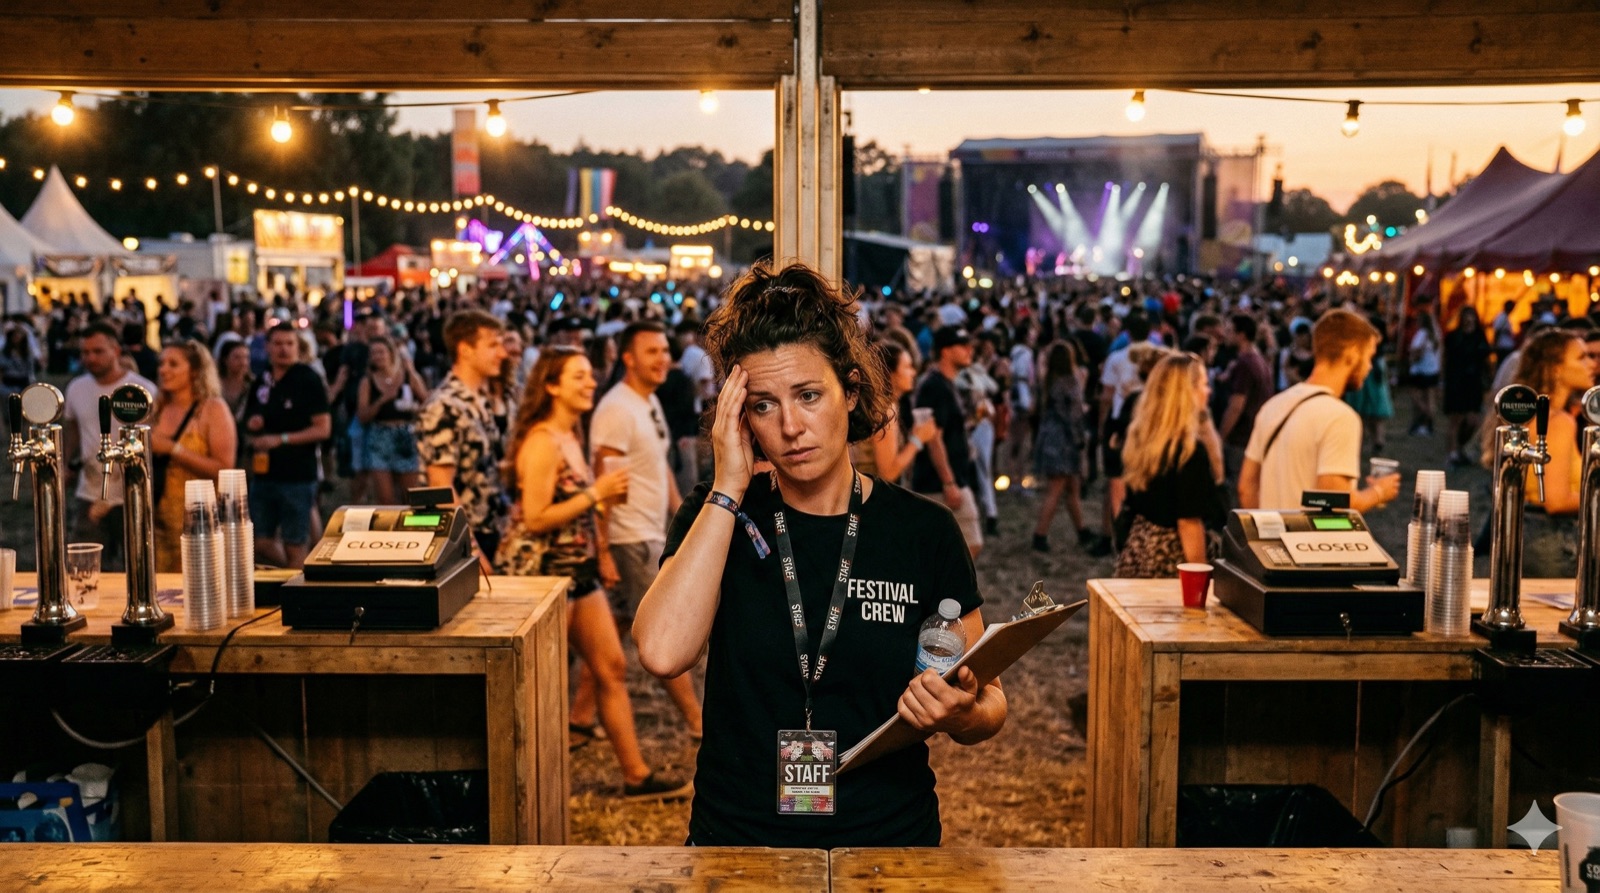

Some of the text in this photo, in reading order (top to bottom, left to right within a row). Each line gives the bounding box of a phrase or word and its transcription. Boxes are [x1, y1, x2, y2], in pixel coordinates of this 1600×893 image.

[347, 540, 420, 550] CLOSED
[1295, 542, 1369, 552] CLOSED
[838, 558, 851, 583] STAFF
[847, 578, 919, 604] FESTIVAL
[861, 601, 905, 624] CREW
[784, 763, 831, 783] STAFF
